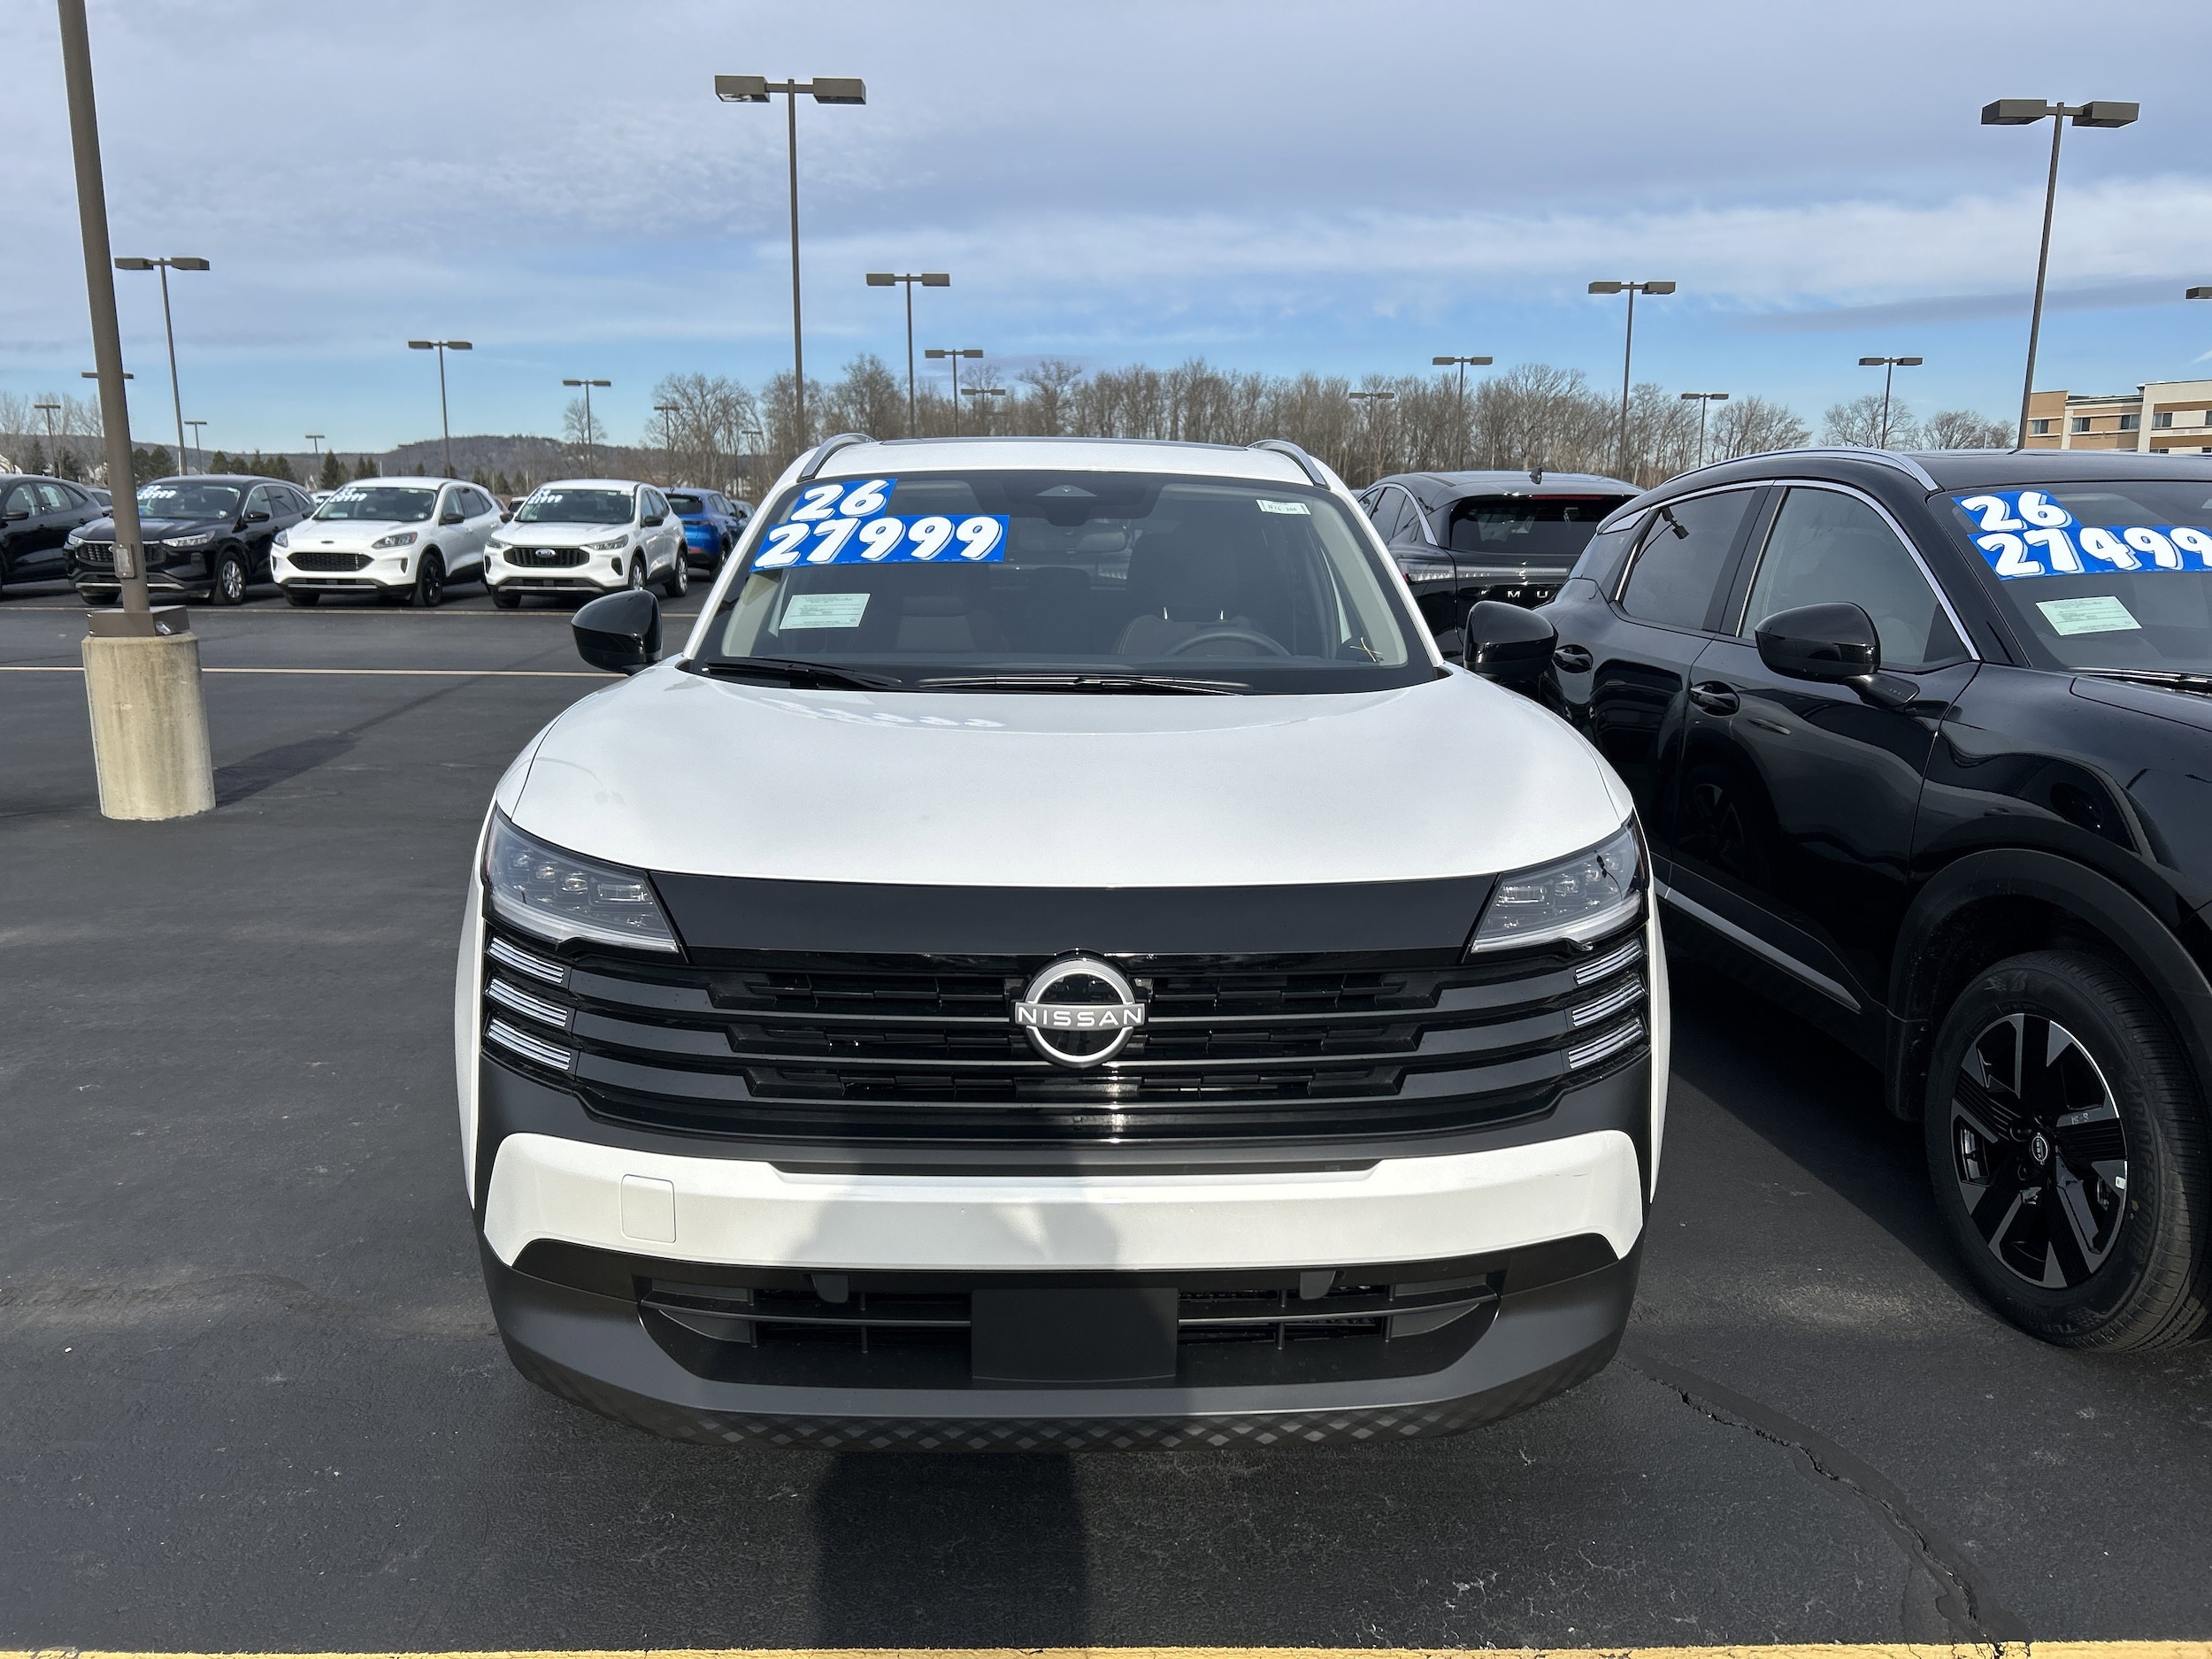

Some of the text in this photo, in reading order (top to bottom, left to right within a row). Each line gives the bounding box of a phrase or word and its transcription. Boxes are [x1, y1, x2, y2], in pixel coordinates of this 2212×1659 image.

[790, 479, 890, 521] 26
[1960, 491, 2073, 532] 26
[754, 516, 1003, 568] 27999
[1977, 526, 2212, 577] 27499
[1018, 1007, 1141, 1026] NISSAN
